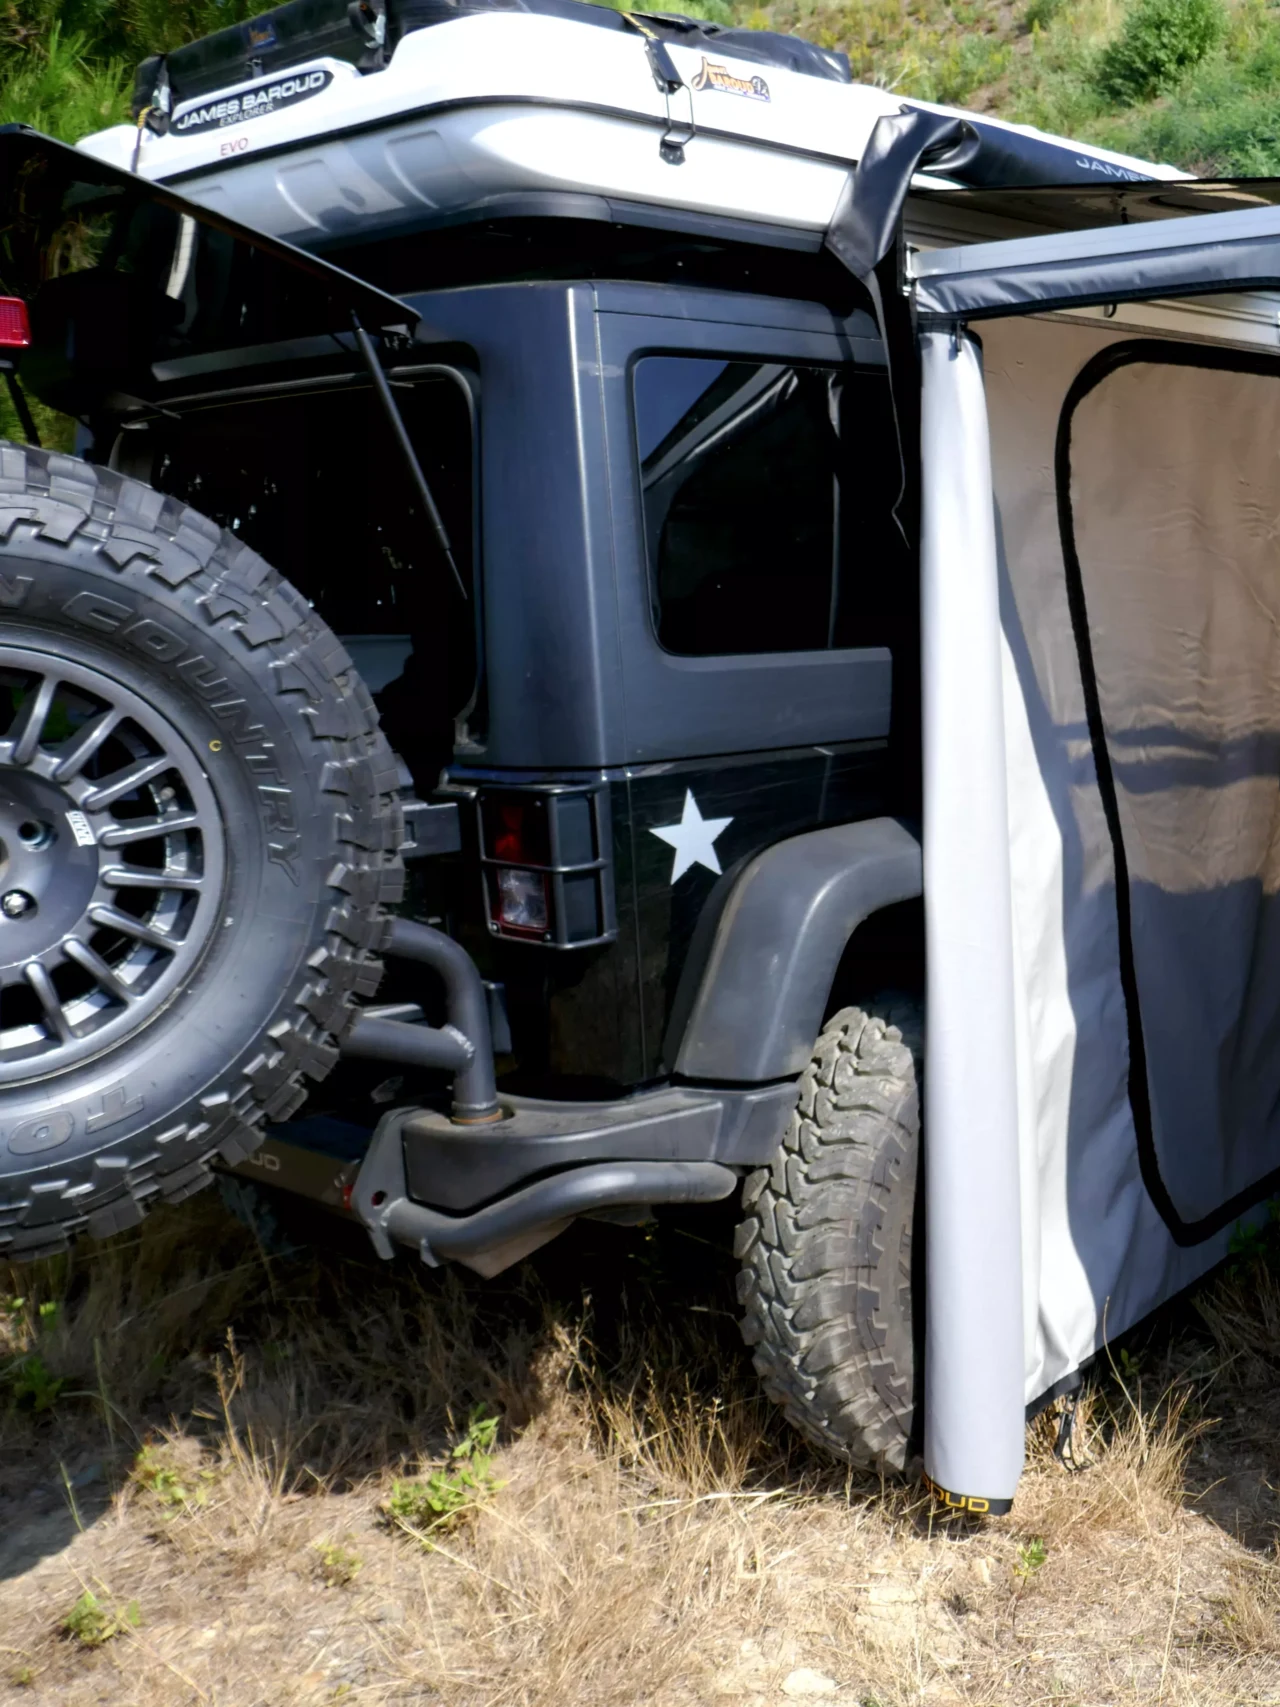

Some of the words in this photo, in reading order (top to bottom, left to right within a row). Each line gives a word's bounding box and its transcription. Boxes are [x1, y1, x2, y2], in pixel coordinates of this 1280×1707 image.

[177, 100, 241, 130] JAMES
[242, 72, 325, 110] BAROUD
[219, 103, 275, 127] EXPLORER
[220, 137, 249, 156] EVO
[61, 591, 301, 887] COUNTRY
